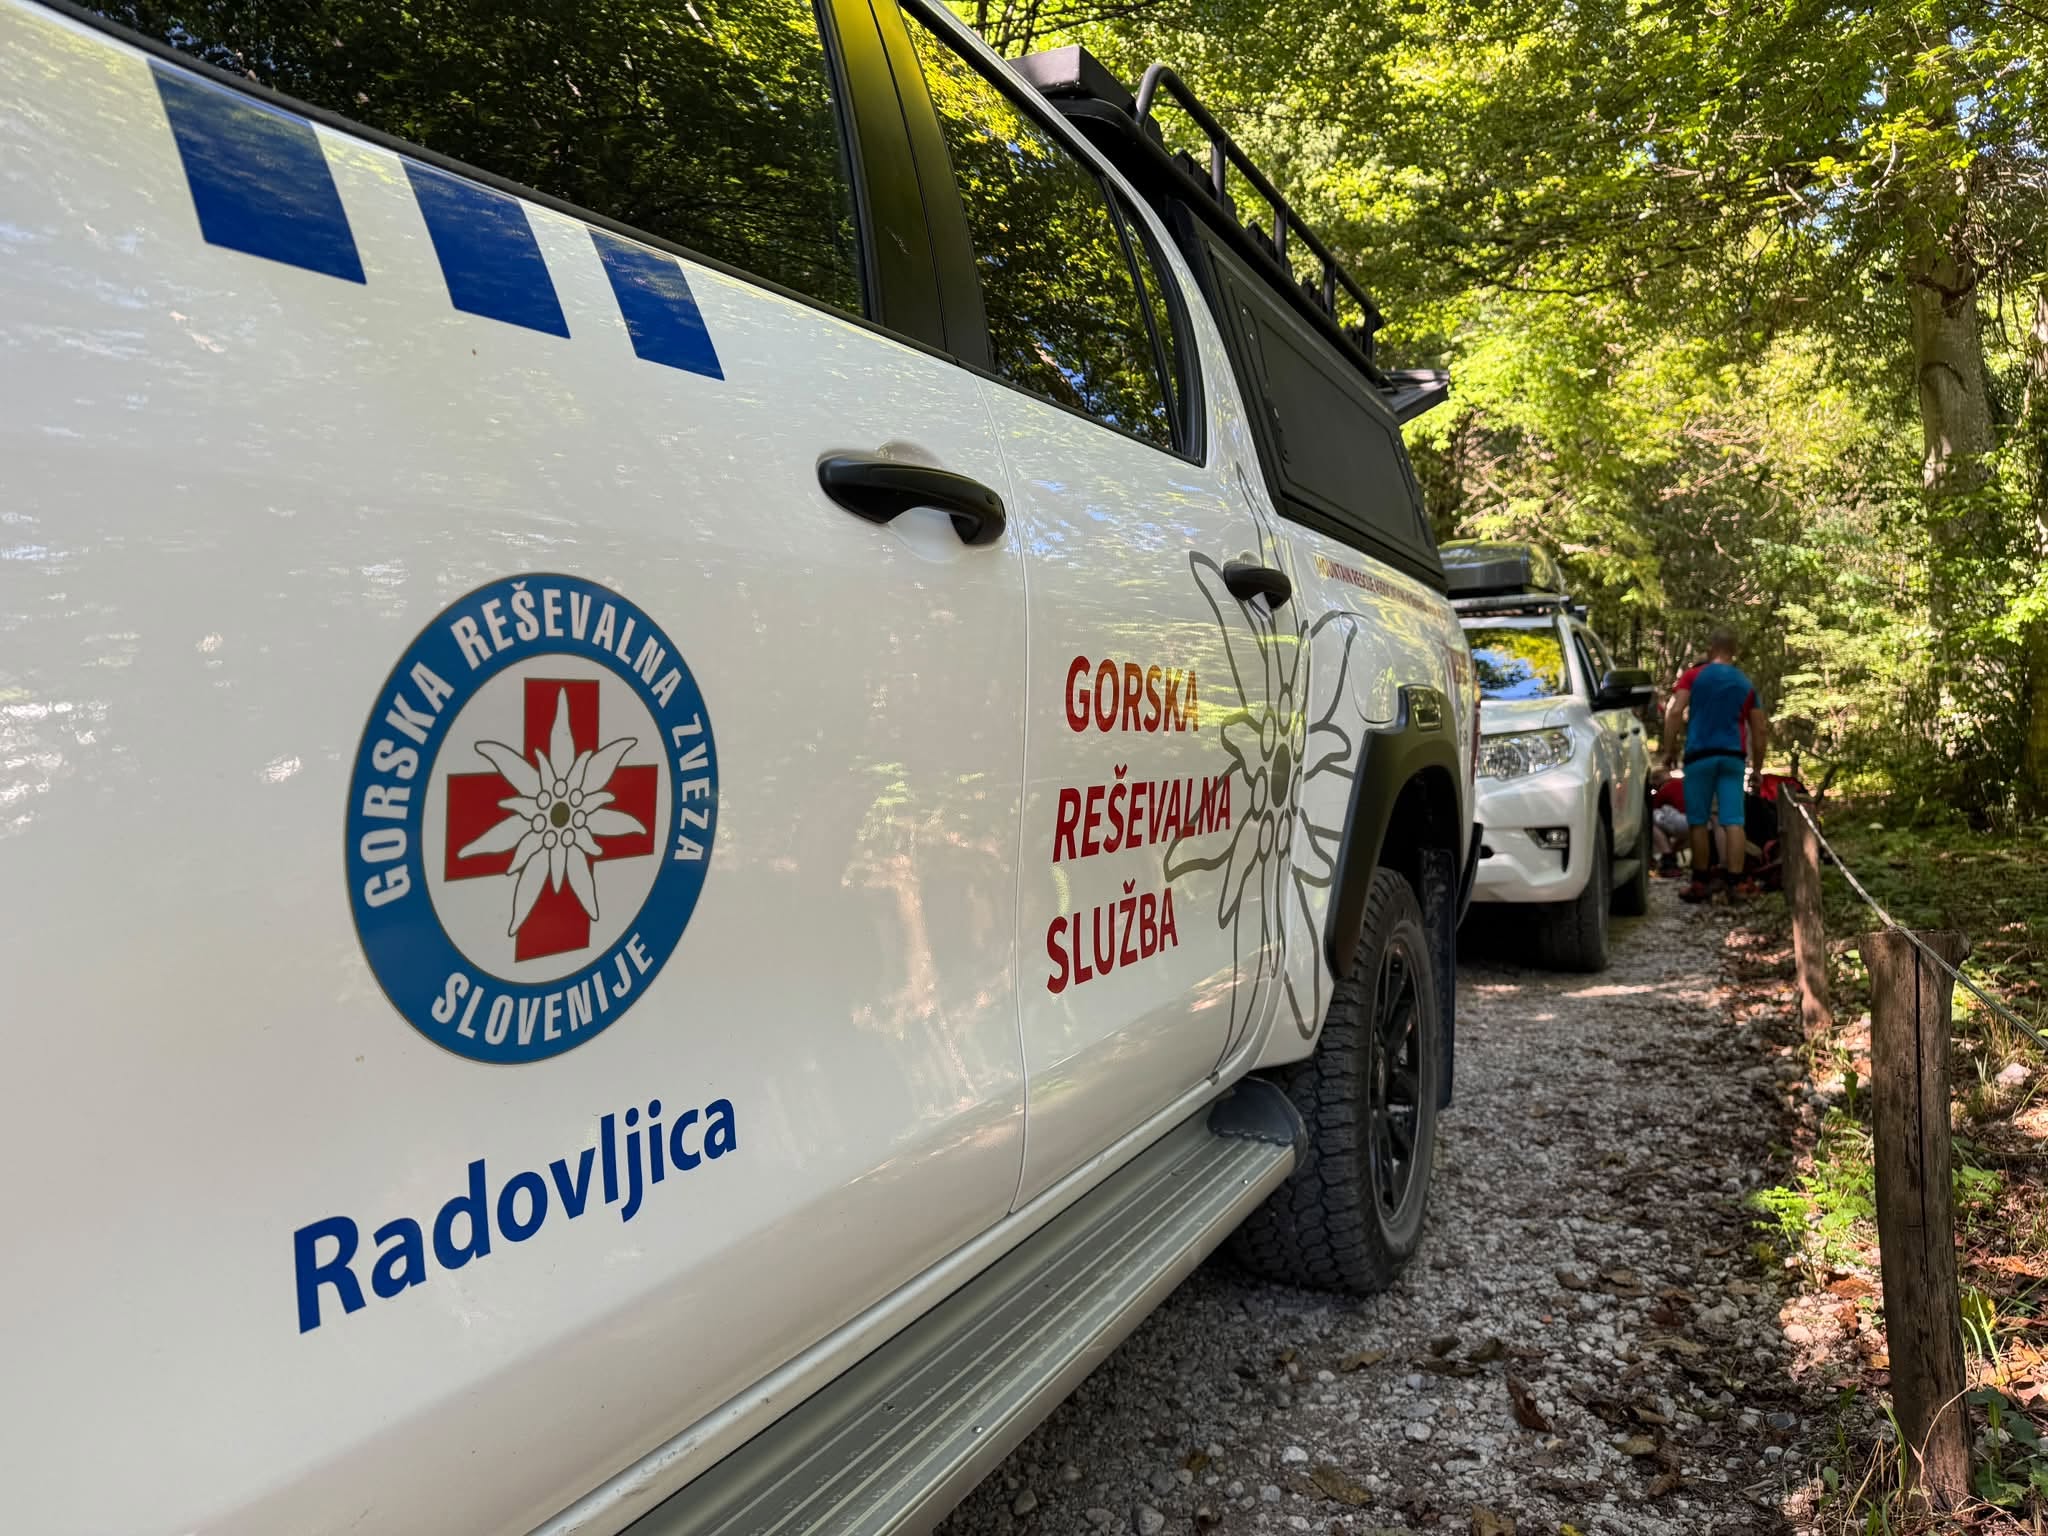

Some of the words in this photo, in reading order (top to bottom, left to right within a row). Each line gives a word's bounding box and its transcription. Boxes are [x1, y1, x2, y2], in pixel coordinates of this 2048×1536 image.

[360, 661, 455, 908] GORSKA
[450, 581, 682, 709] REŠEVALNA
[671, 712, 711, 861] ZVEZA
[1064, 655, 1200, 733] GORSKA
[1052, 763, 1232, 863] REŠEVALNA
[431, 932, 654, 1046] SLOVENIJE
[1046, 878, 1179, 994] SLUŽBA
[293, 1098, 737, 1334] Radovljica
